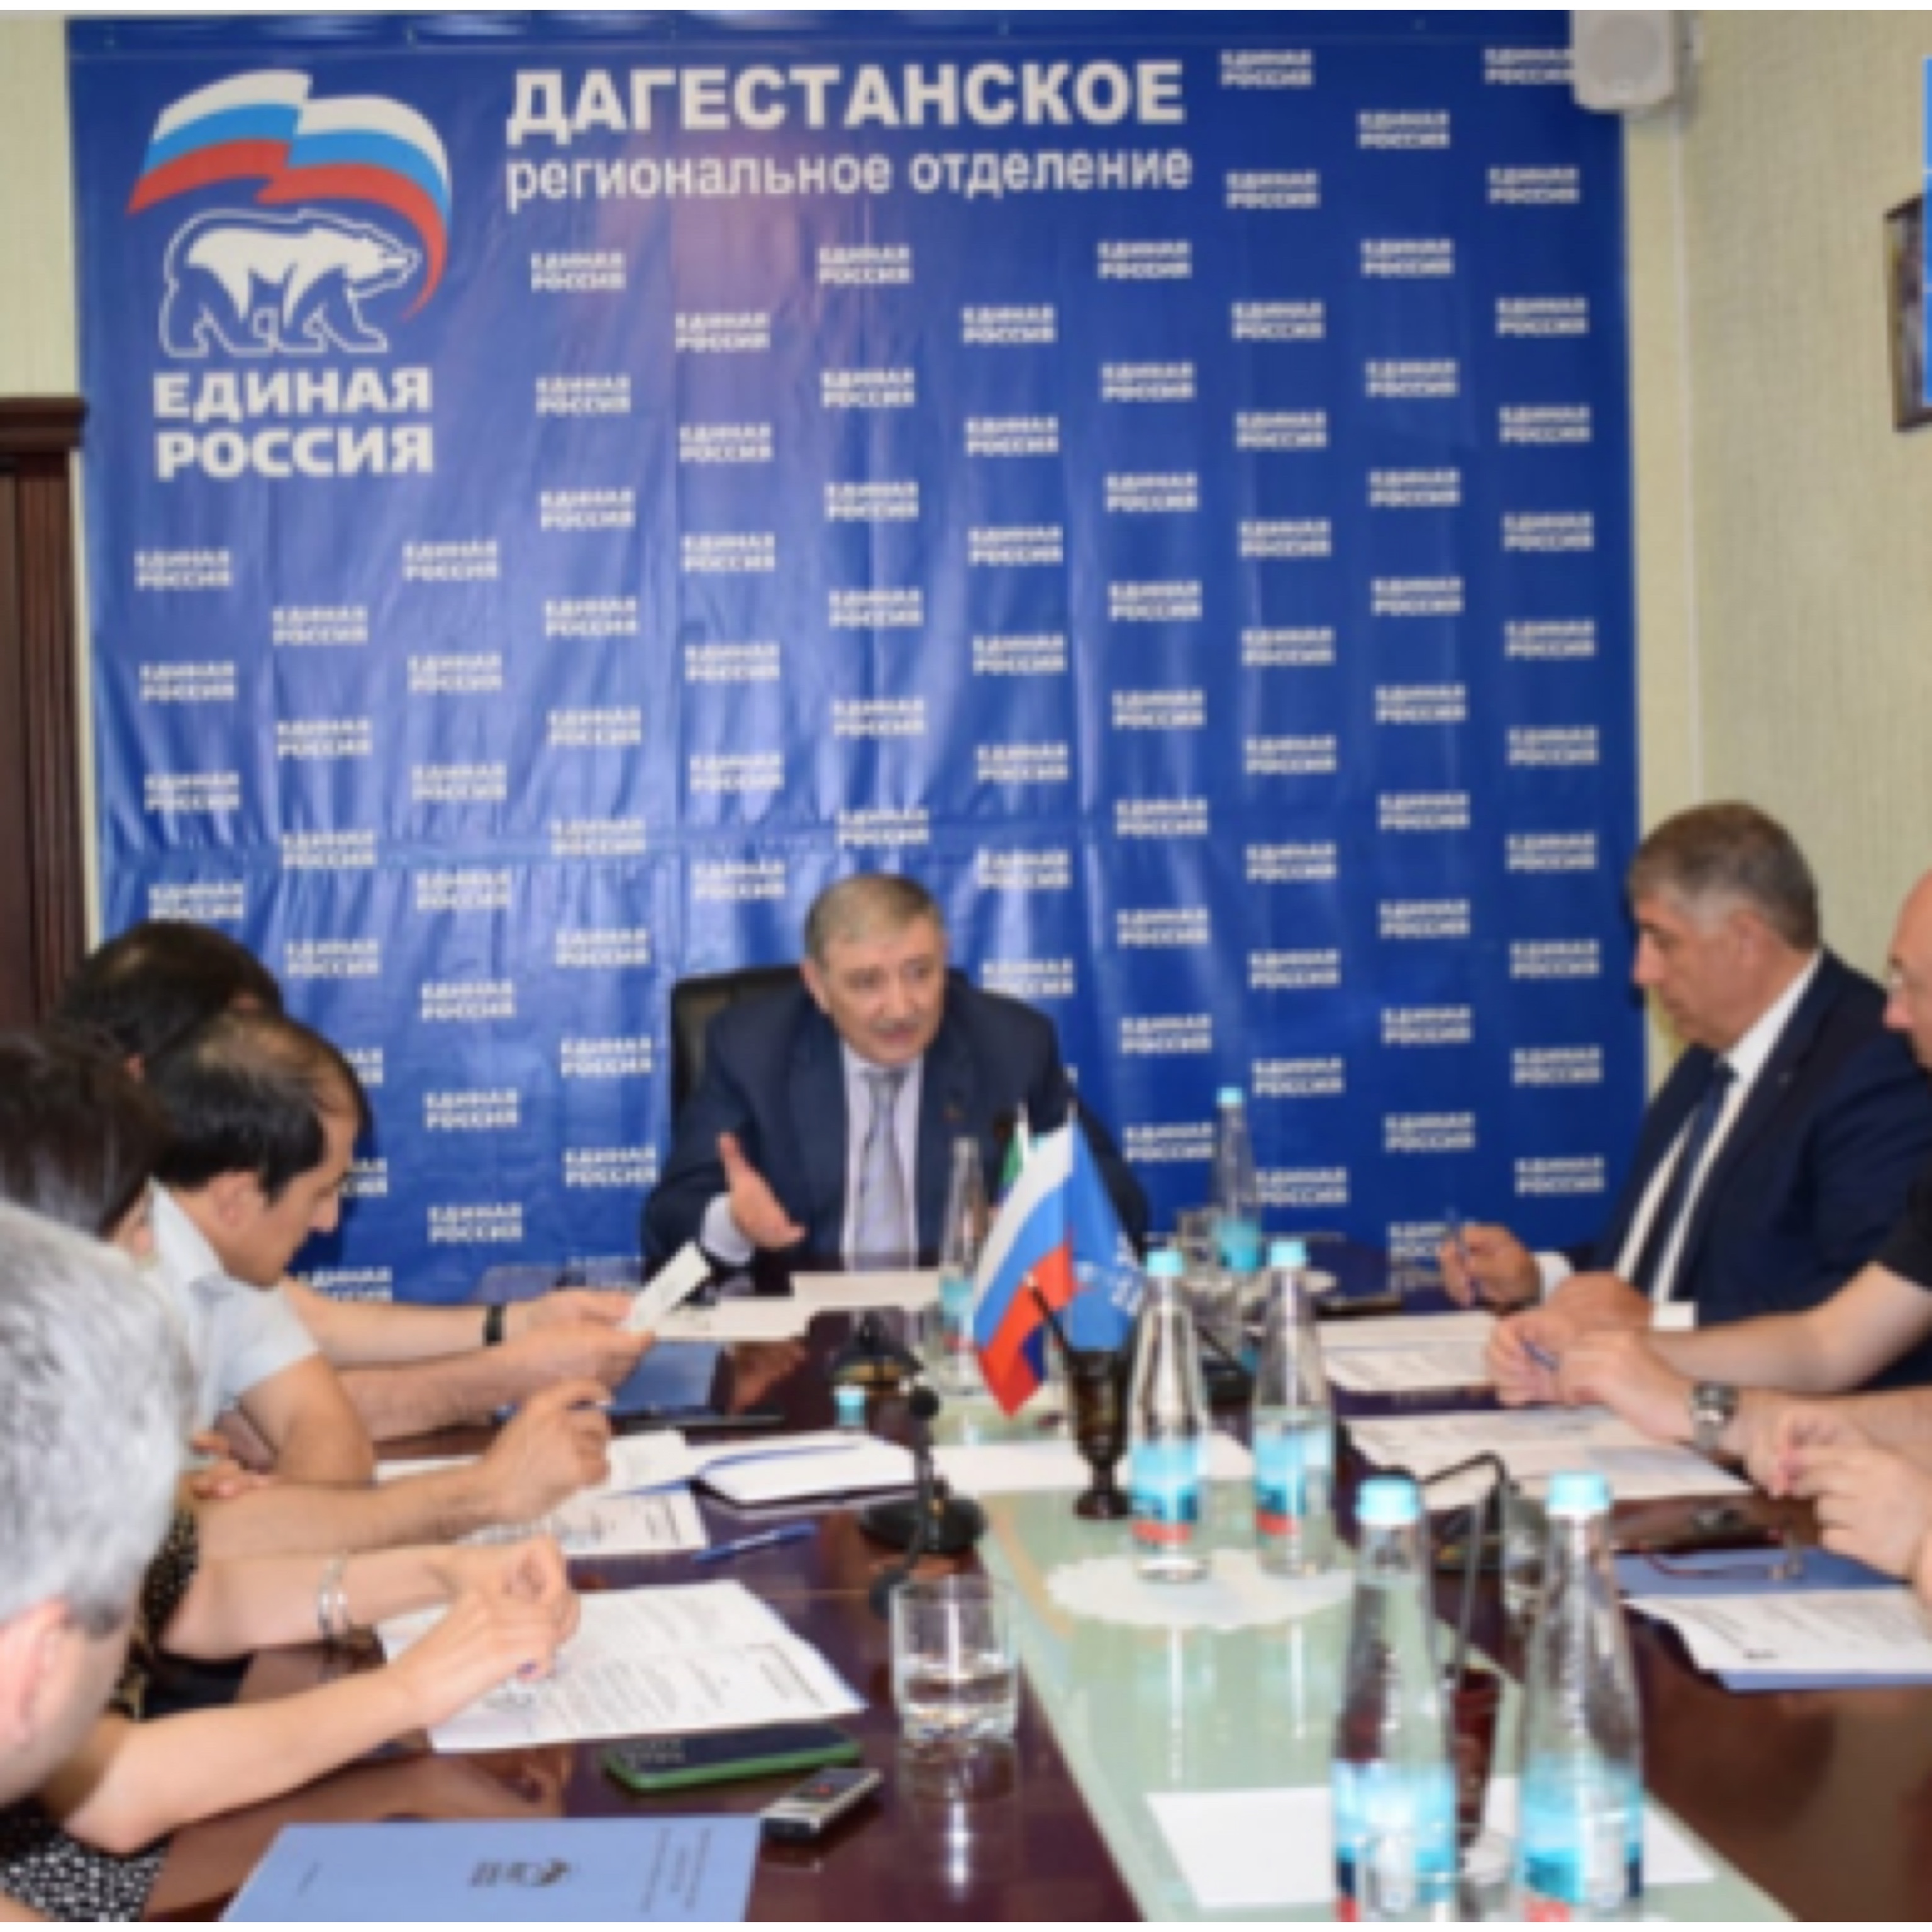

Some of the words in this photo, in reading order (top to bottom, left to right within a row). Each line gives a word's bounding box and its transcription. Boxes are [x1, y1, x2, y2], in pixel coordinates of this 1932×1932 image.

[507, 61, 1184, 146] ДАГЕСТАНСКОЕ
[508, 156, 890, 211] региональное
[910, 150, 1191, 198] отделение
[155, 369, 430, 422] ЕДИНАЯ
[157, 427, 431, 479] РОССИЯ
